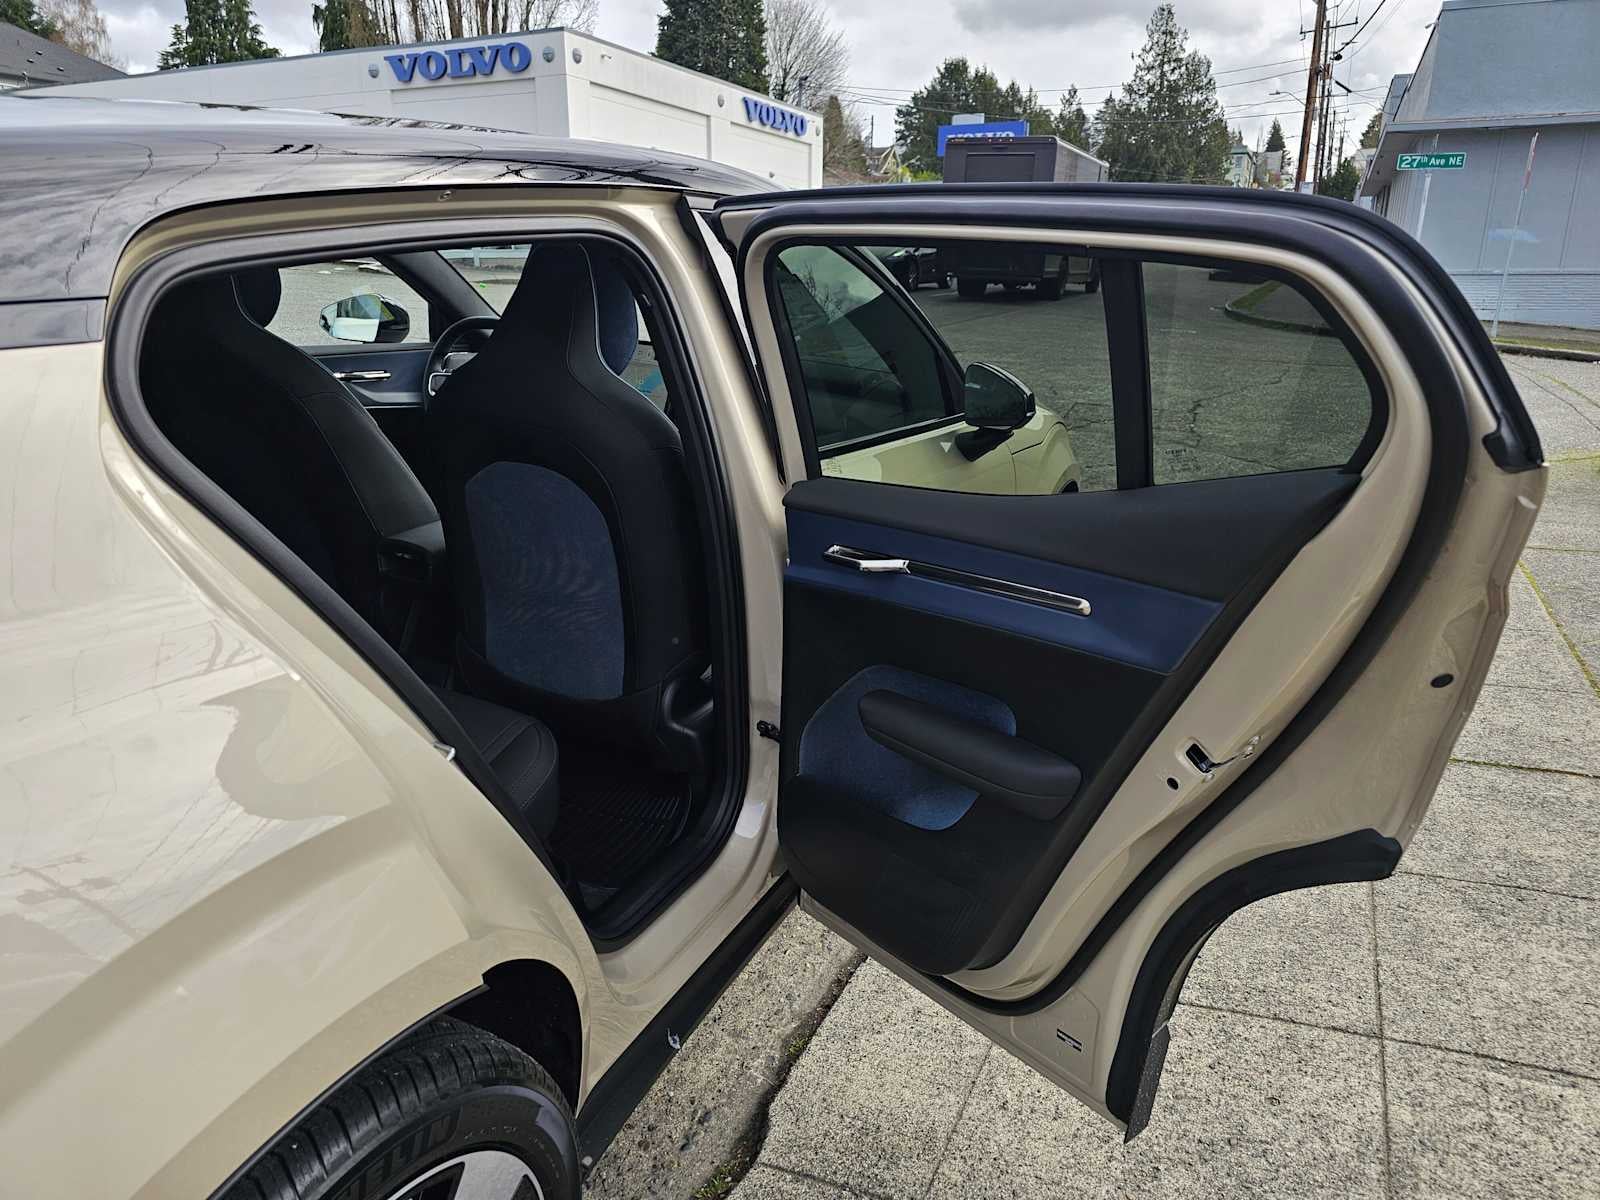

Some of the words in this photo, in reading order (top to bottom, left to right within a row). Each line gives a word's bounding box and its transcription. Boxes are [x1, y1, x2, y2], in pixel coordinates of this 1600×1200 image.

[384, 42, 532, 82] VOLVO
[743, 97, 807, 136] VOLVO
[1401, 156, 1427, 168] 27th
[1428, 157, 1446, 166] Ave
[1448, 156, 1464, 166] NE
